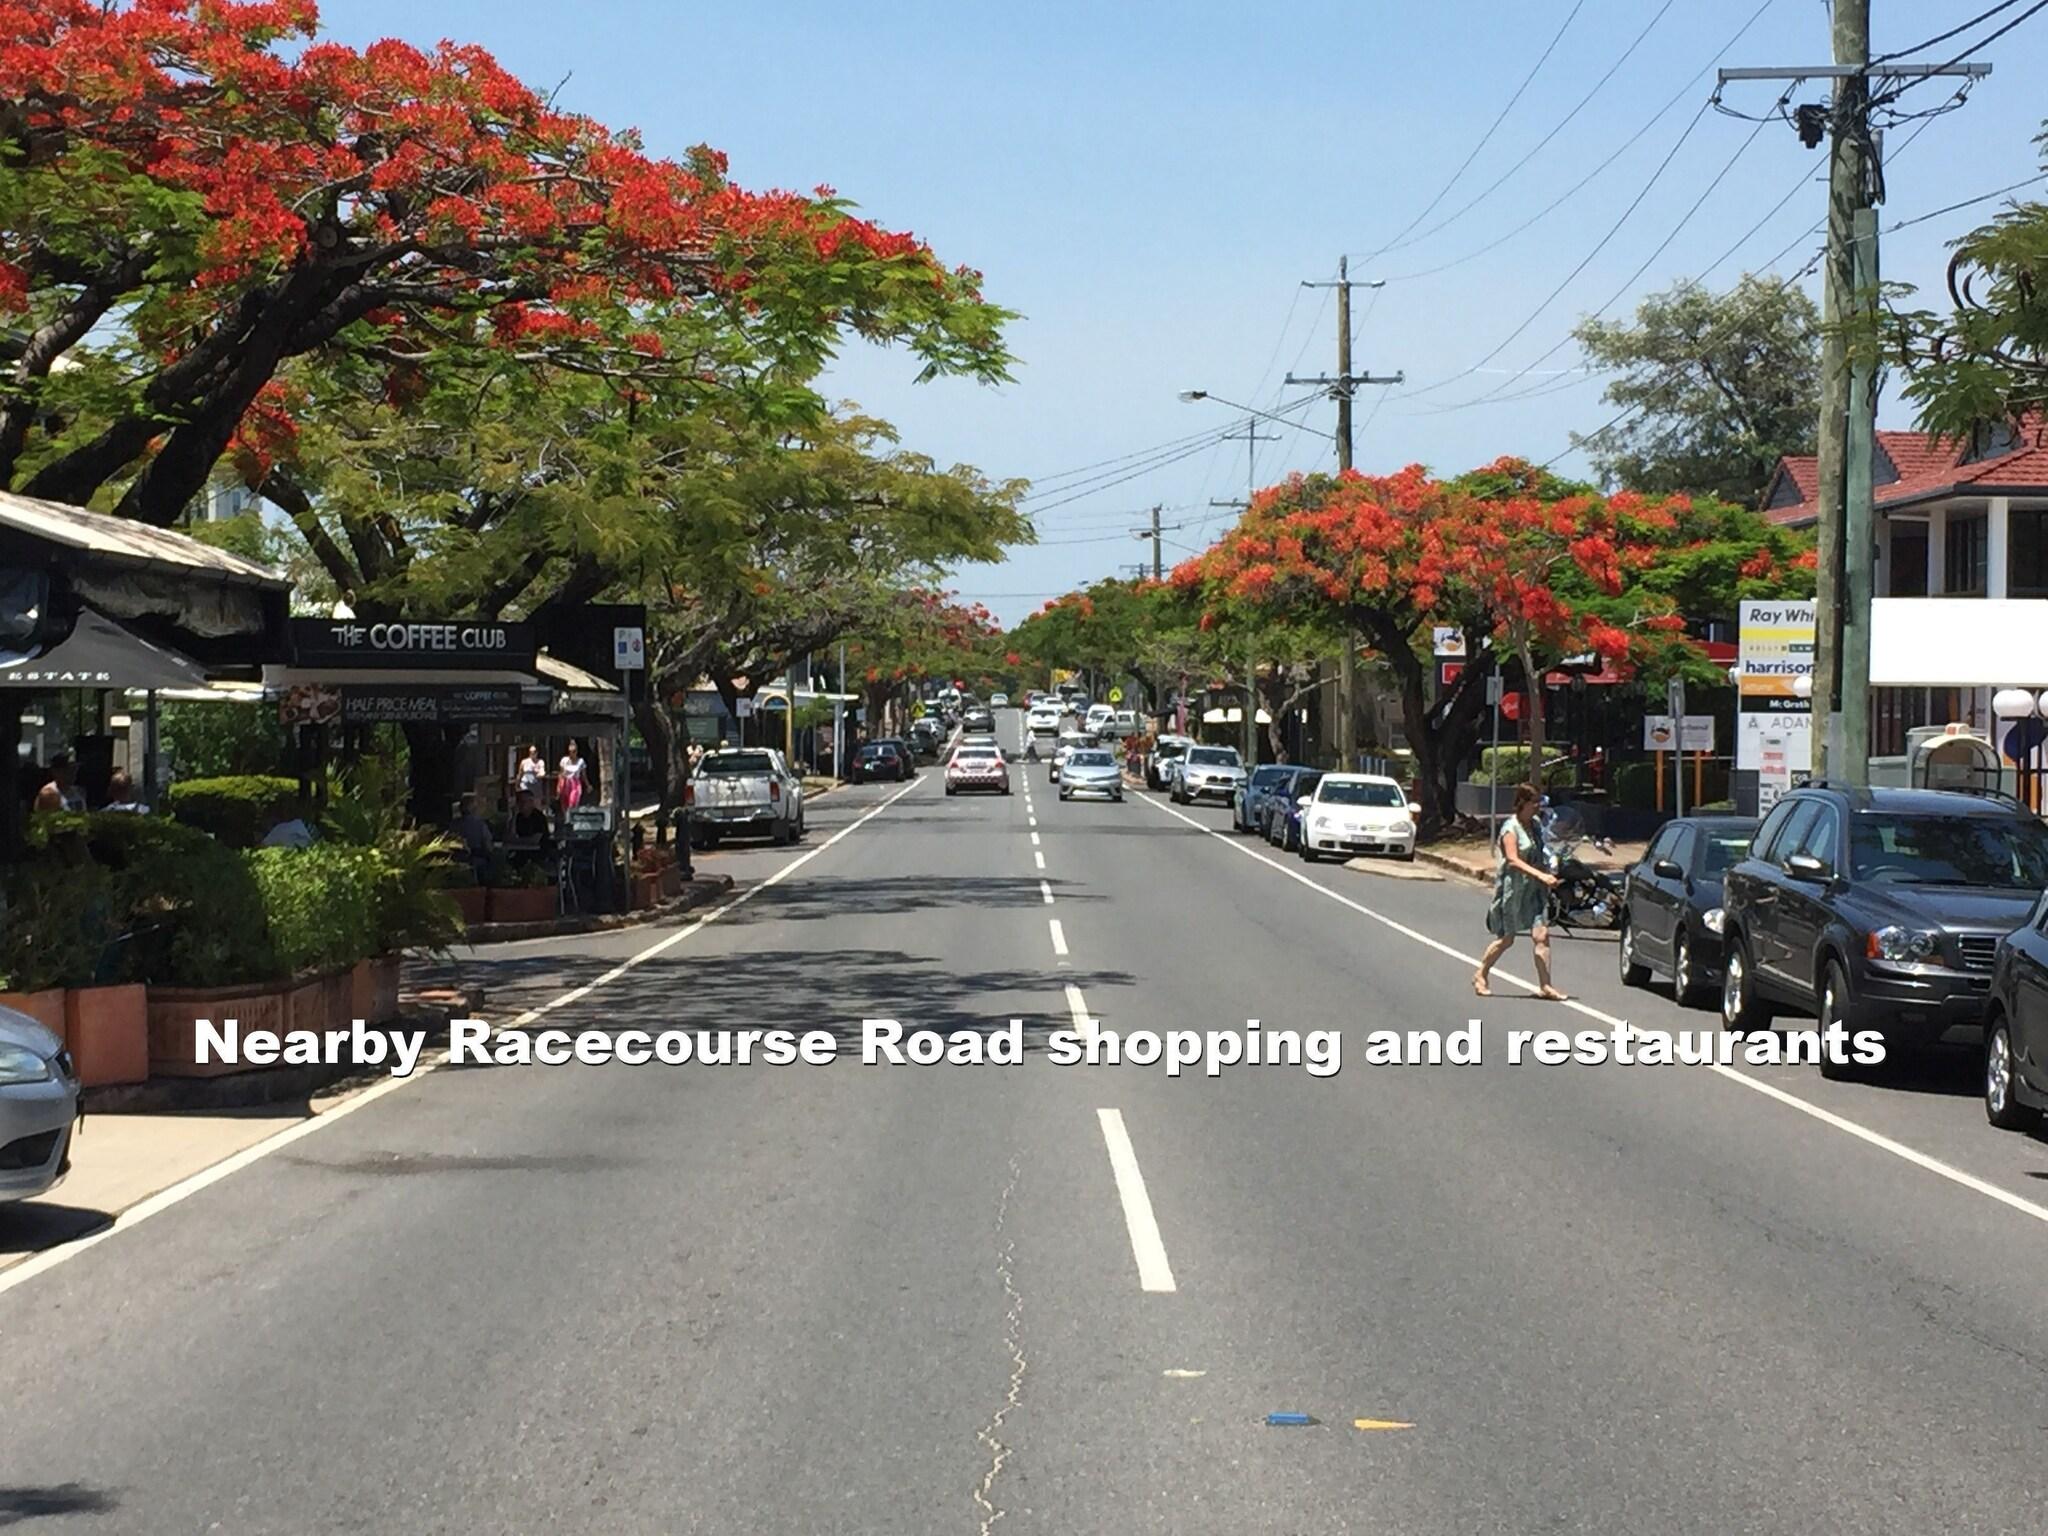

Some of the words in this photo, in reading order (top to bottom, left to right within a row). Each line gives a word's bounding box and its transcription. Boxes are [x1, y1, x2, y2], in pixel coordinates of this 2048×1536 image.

[1749, 608, 1781, 624] Ray
[1785, 608, 1815, 622] Whi
[331, 624, 367, 647] THE
[370, 623, 457, 649] COFFEE
[461, 628, 506, 648] CLUB
[8, 671, 111, 681] ESTATE
[345, 697, 374, 711] HALF
[376, 697, 407, 711] PRICE
[408, 697, 438, 711] MEAL
